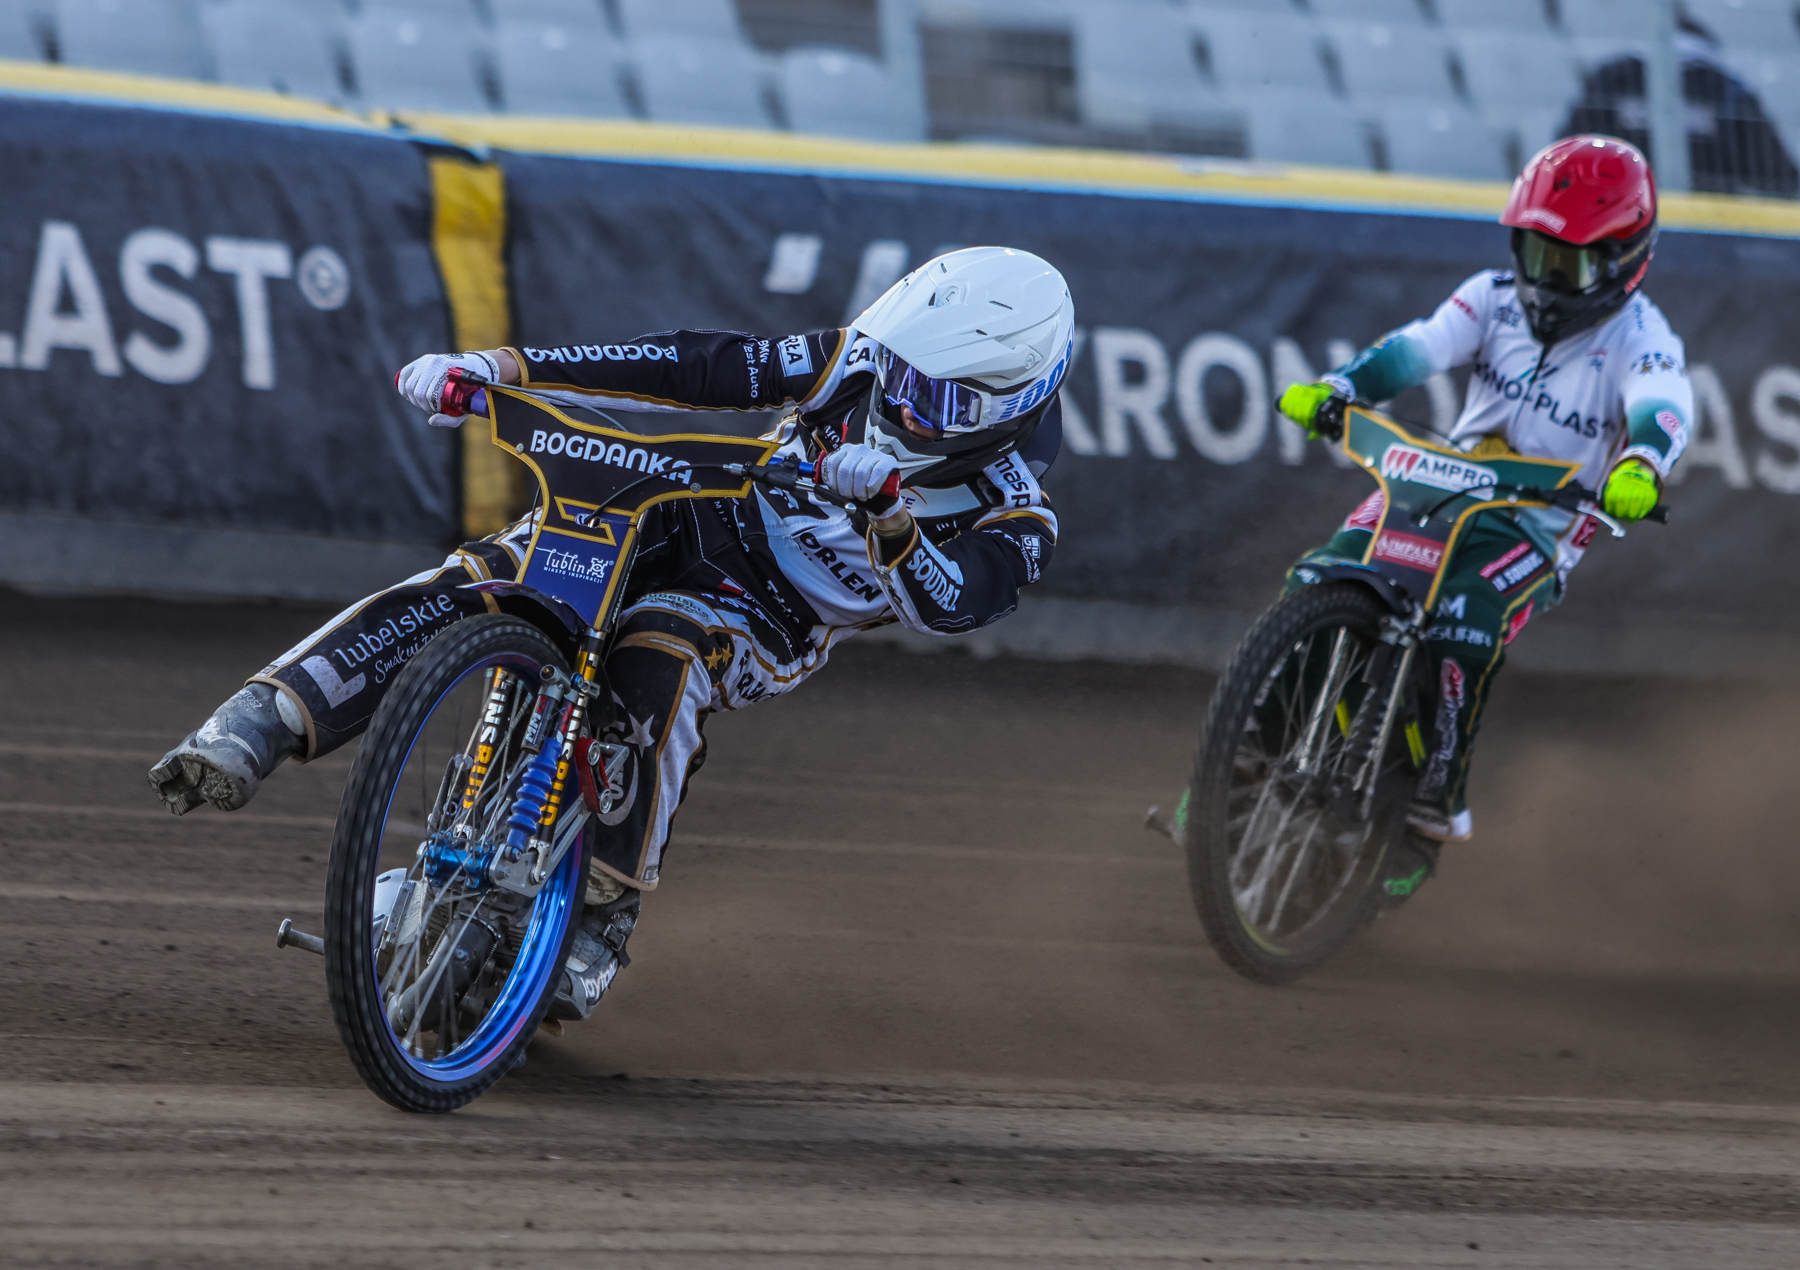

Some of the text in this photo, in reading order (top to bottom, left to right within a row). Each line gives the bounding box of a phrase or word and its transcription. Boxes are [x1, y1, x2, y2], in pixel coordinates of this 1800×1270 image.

[0, 219, 292, 391] AST
[846, 347, 876, 367] CA
[530, 429, 693, 485] BOGDANKA
[543, 566, 567, 576] MIASTO
[335, 594, 455, 669] lubelskie
